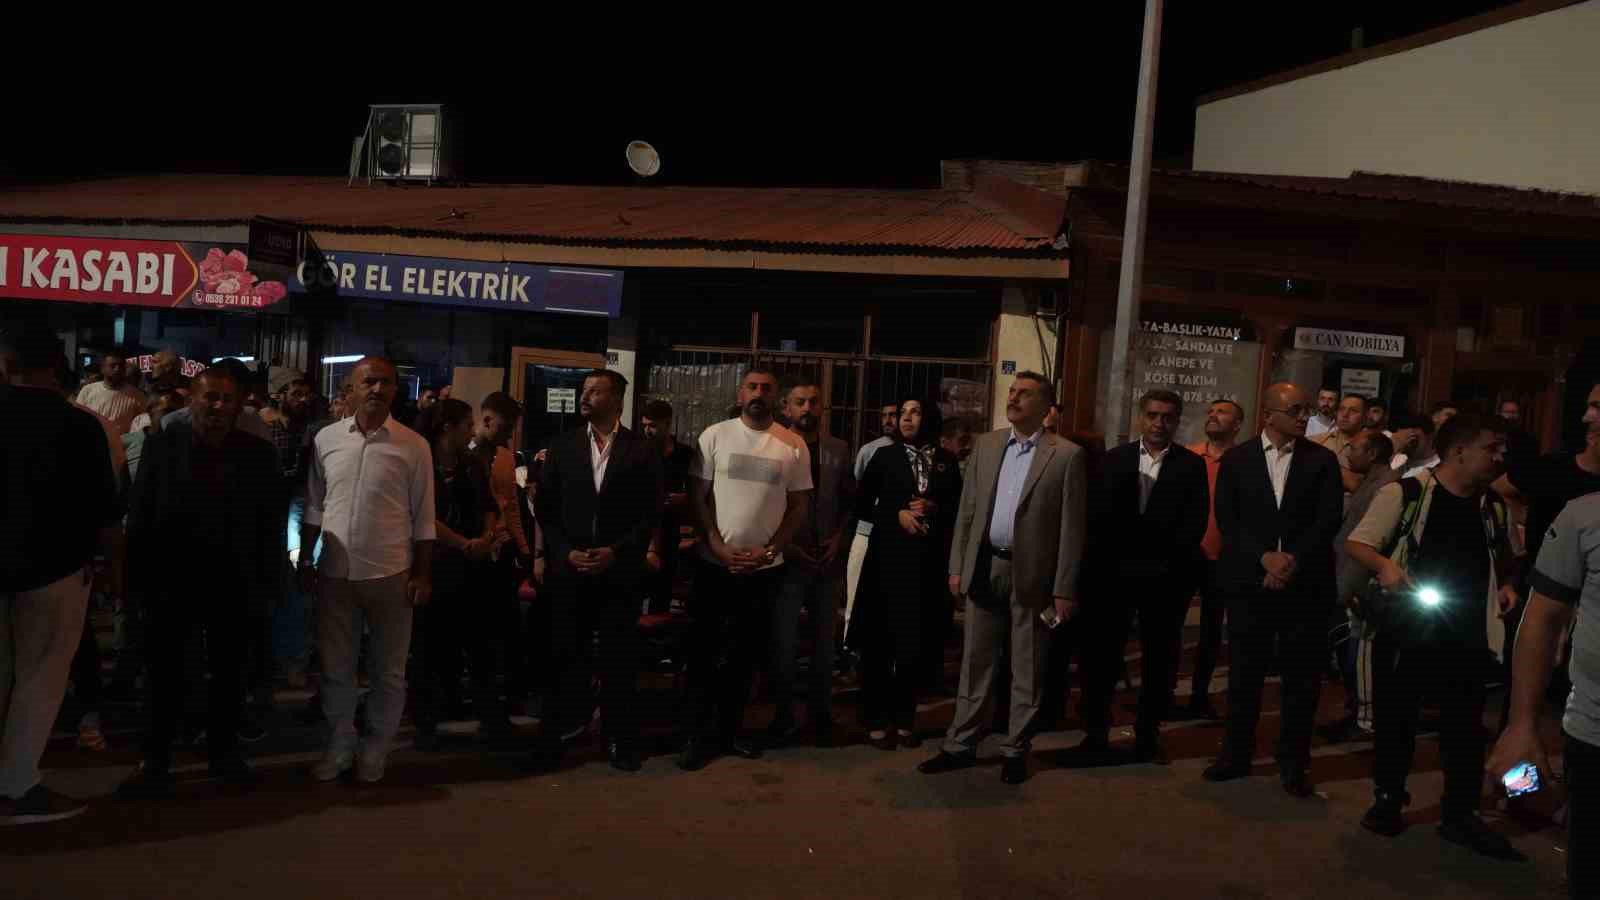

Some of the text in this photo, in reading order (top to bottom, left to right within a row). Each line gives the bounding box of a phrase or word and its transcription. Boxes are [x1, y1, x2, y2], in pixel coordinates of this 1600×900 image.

[22, 247, 176, 297] KASABI
[365, 264, 393, 292] EL
[402, 263, 531, 303] ELEKTRİK
[1314, 333, 1341, 347] CAN
[1175, 340, 1233, 355] SANDALYE
[1199, 359, 1216, 370] VE
[1178, 374, 1217, 386] TAKIMI
